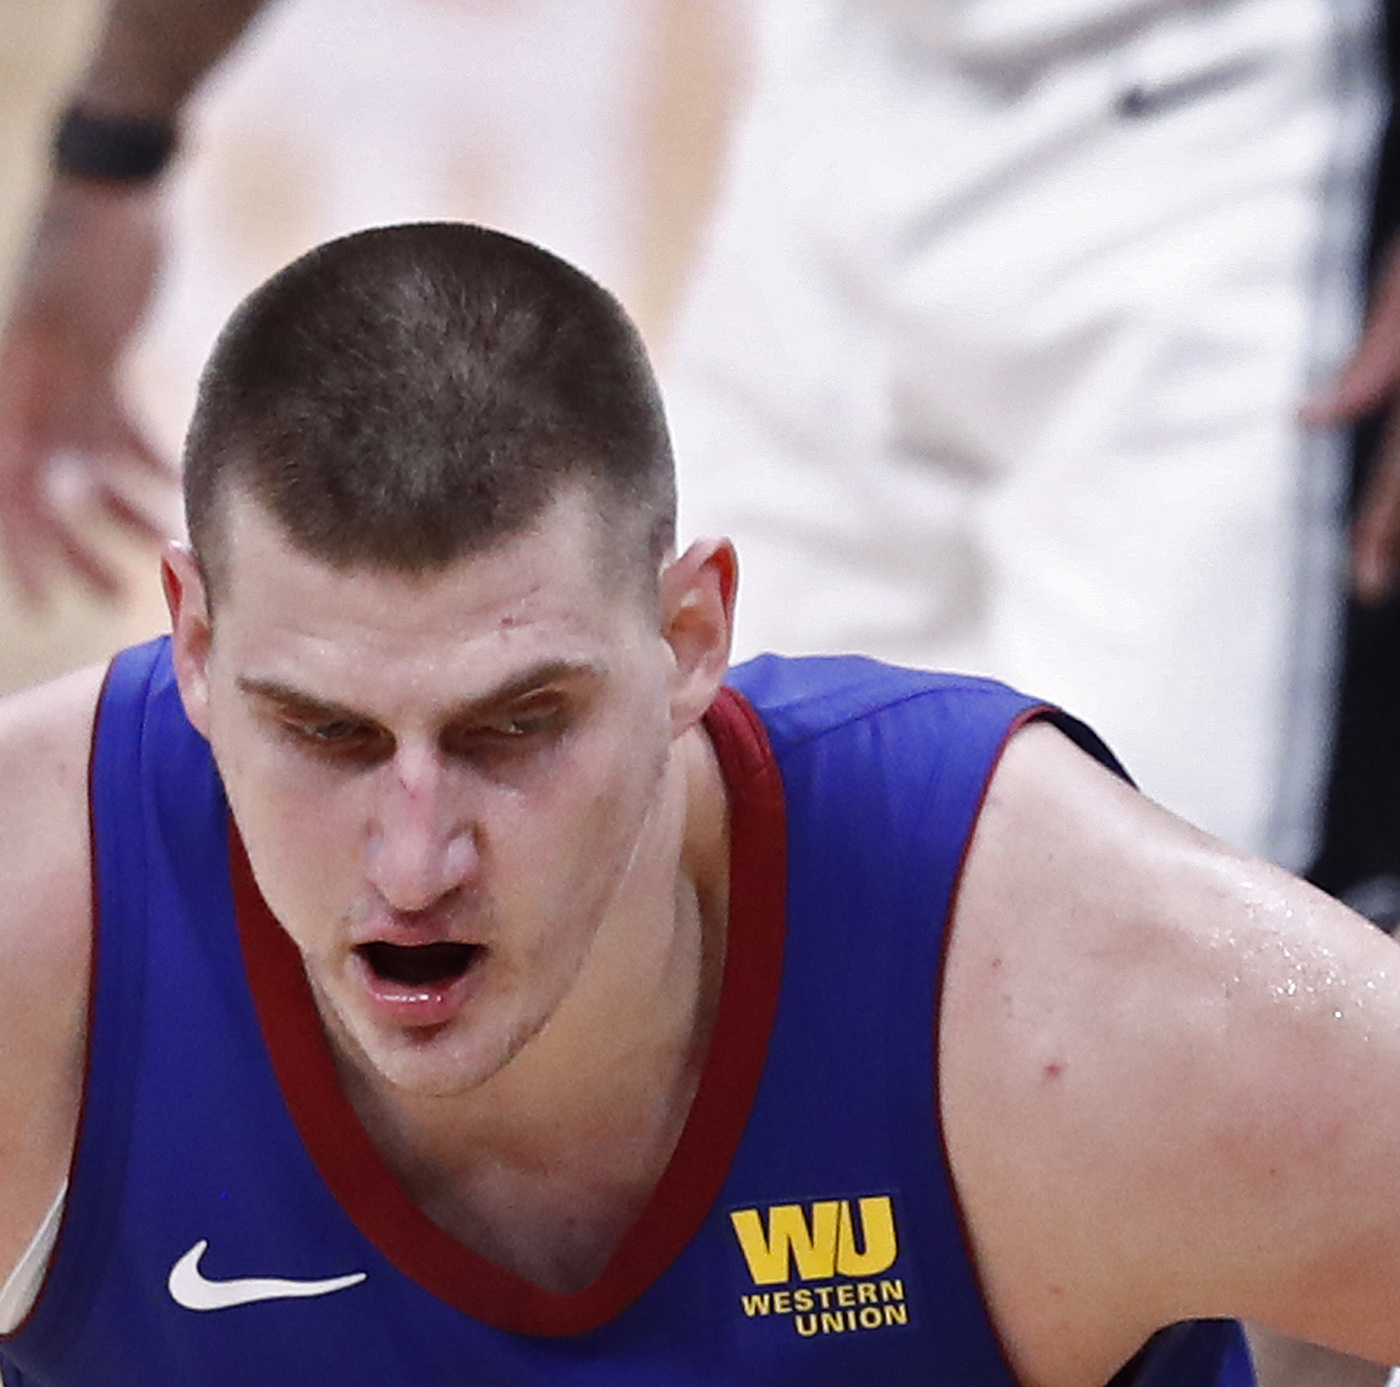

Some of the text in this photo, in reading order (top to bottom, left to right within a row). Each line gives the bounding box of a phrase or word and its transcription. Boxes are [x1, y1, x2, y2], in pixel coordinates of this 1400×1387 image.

[730, 1196, 898, 1285] WU
[741, 1279, 904, 1317] WESTERN
[795, 1303, 909, 1337] UNION
